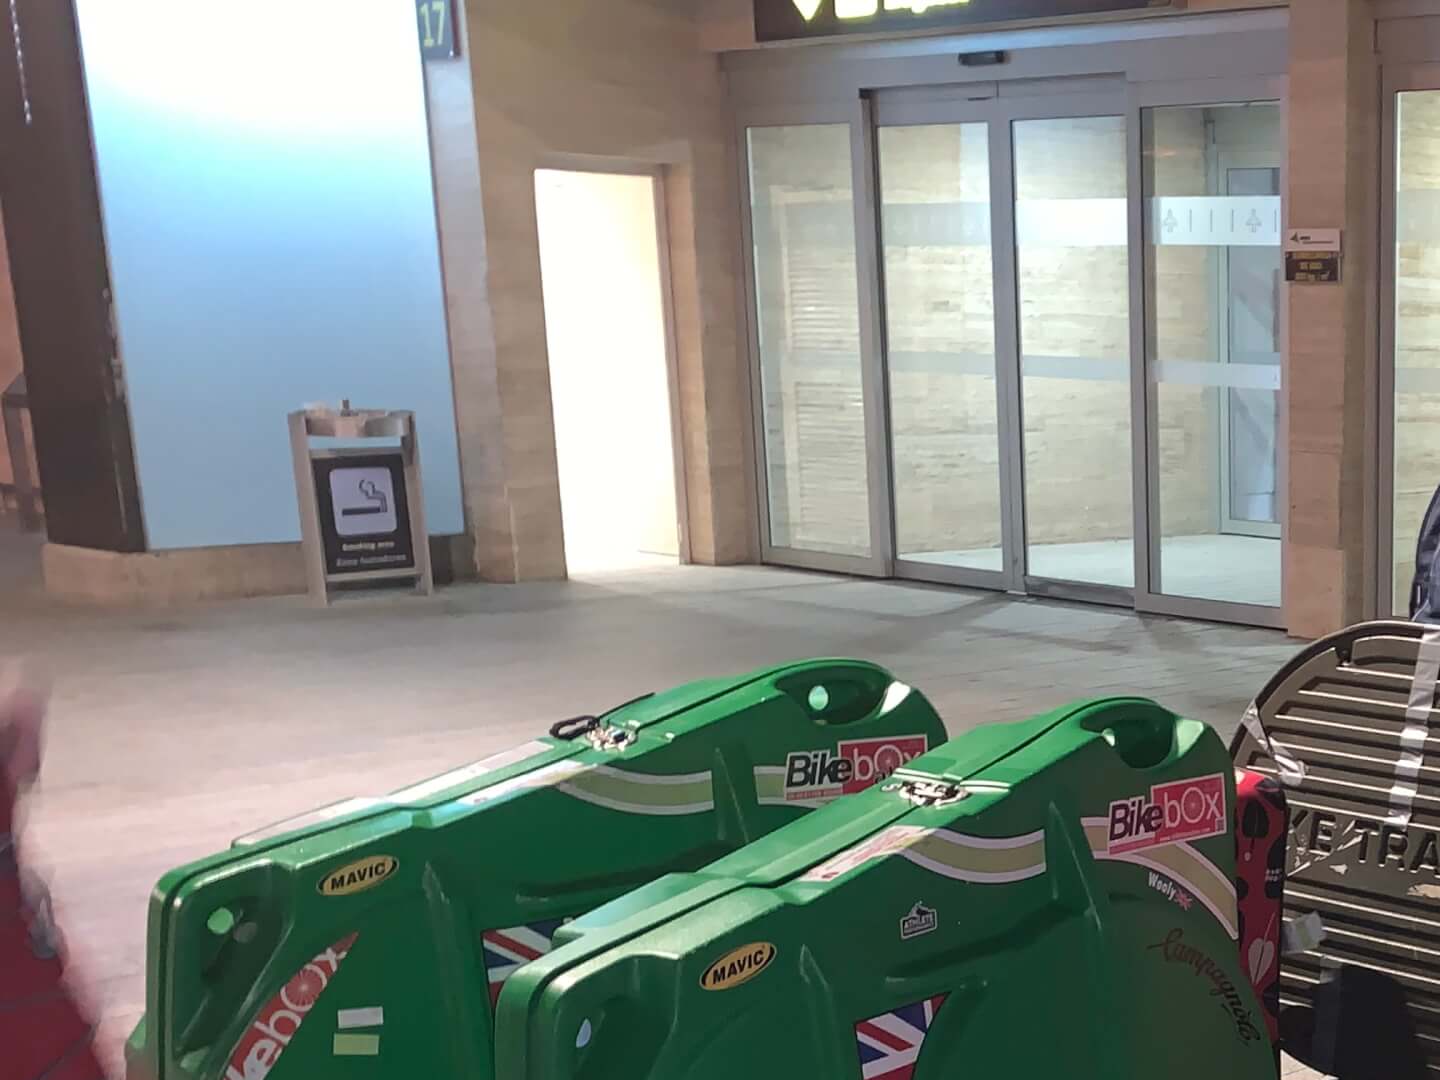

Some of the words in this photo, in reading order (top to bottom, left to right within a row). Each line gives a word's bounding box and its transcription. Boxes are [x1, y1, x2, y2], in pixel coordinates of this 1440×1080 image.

[419, 1, 445, 48] 17
[331, 861, 386, 891] MAVIC
[1148, 871, 1177, 901] Wooly
[712, 949, 765, 985] MAVIC
